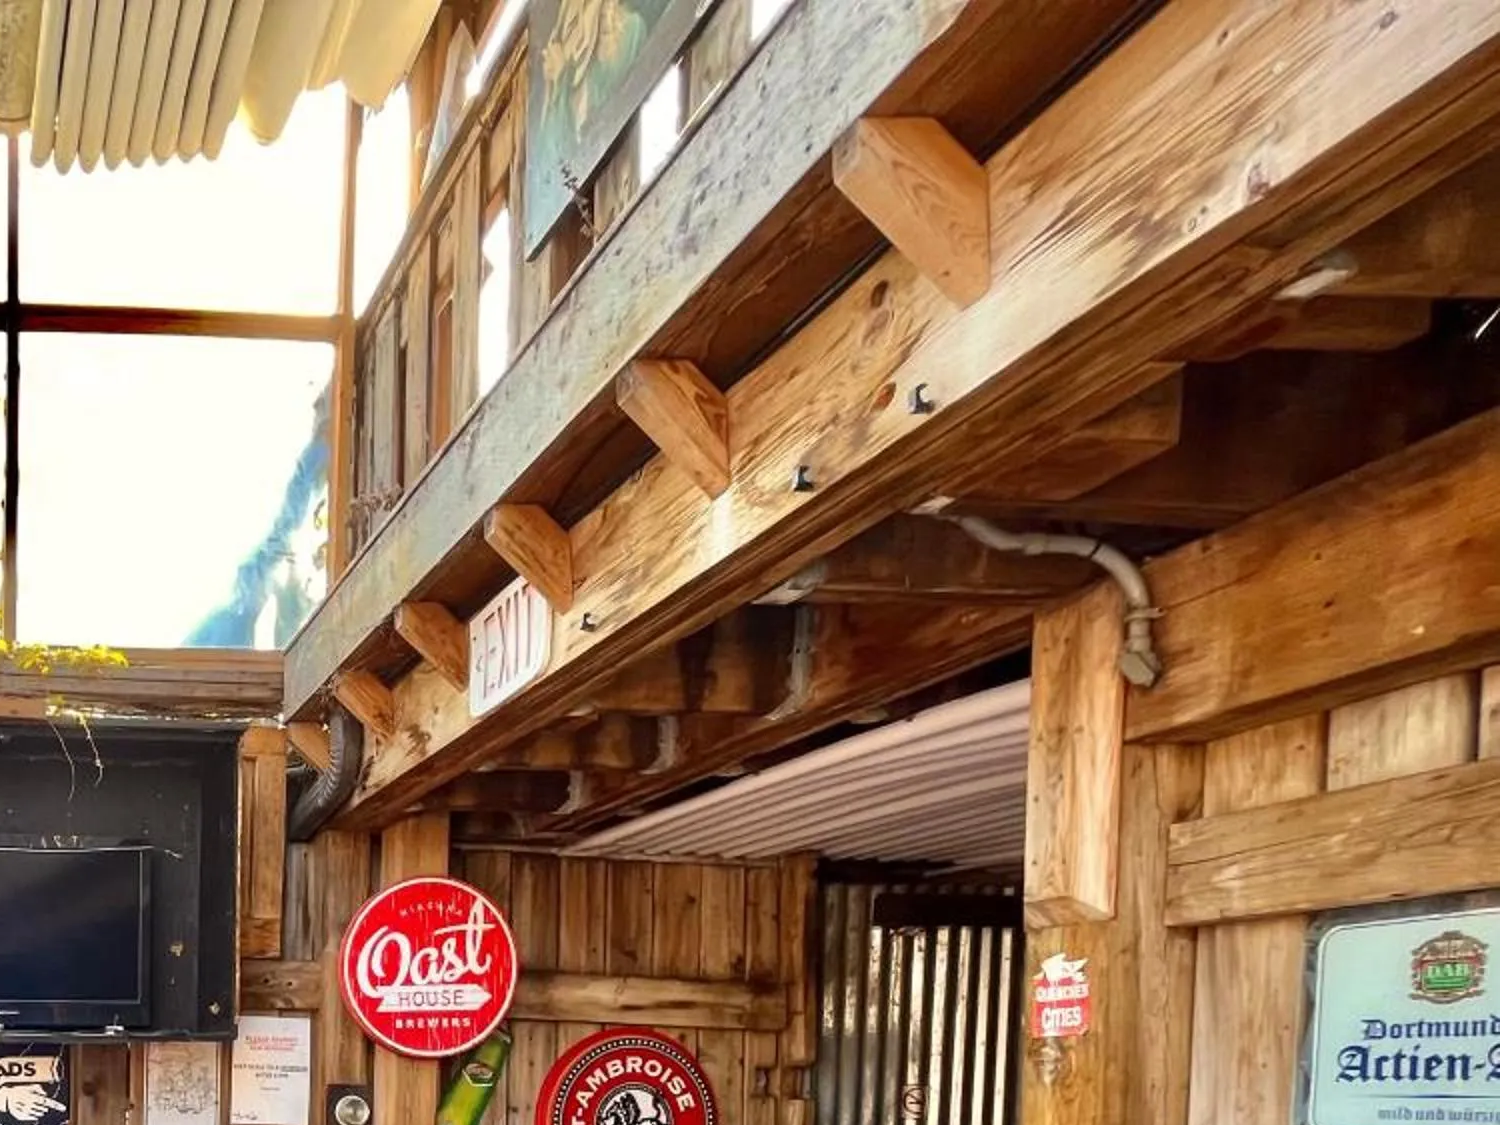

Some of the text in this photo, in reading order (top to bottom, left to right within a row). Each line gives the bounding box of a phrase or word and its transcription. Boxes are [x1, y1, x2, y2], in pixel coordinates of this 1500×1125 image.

[483, 581, 532, 700] EXIT
[356, 900, 497, 998] Oast
[395, 1016, 472, 1029] BREWERS
[398, 989, 465, 1007] HOUSE
